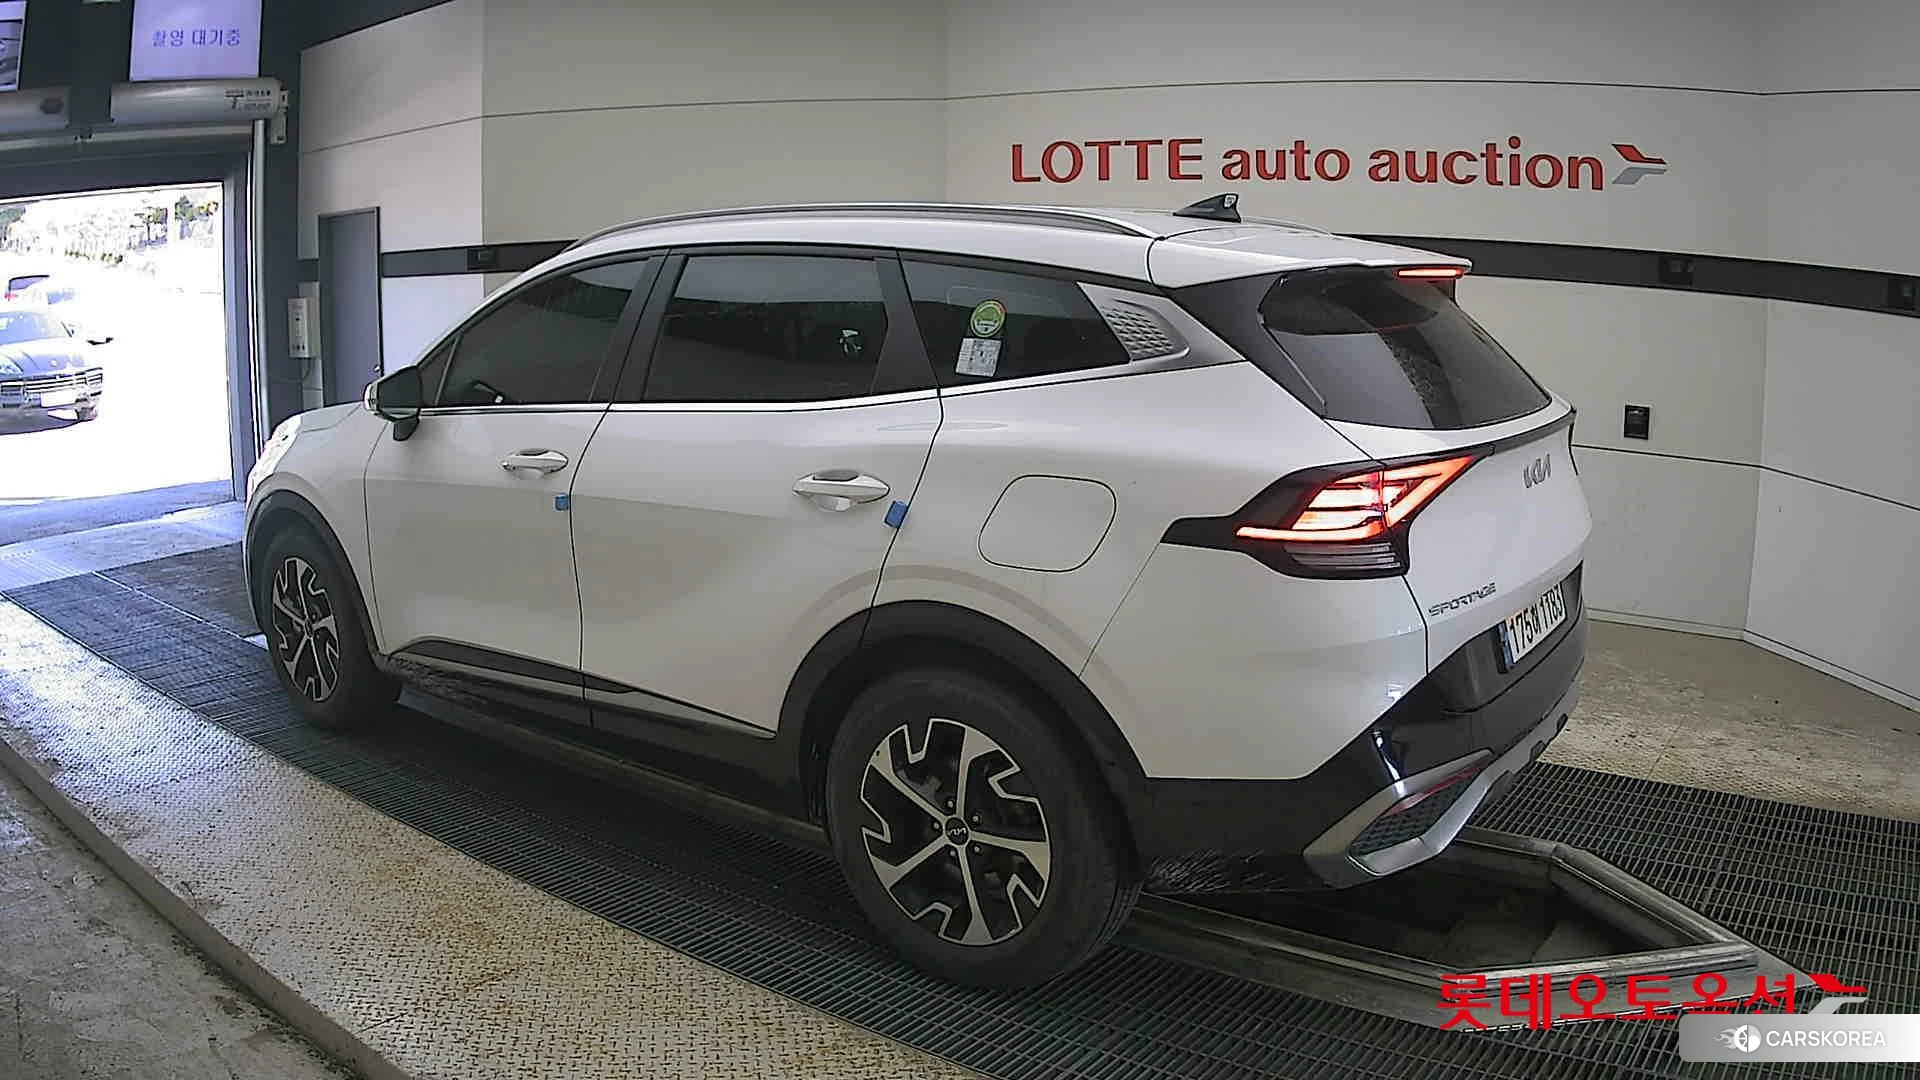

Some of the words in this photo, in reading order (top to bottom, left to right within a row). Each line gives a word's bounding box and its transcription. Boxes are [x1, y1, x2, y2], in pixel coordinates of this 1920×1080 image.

[192, 28, 241, 47] 대기중
[1011, 138, 1203, 183] LOTTE
[1221, 140, 1350, 181] auto
[1368, 135, 1604, 191] auction
[1428, 582, 1497, 616] SPORTAGE
